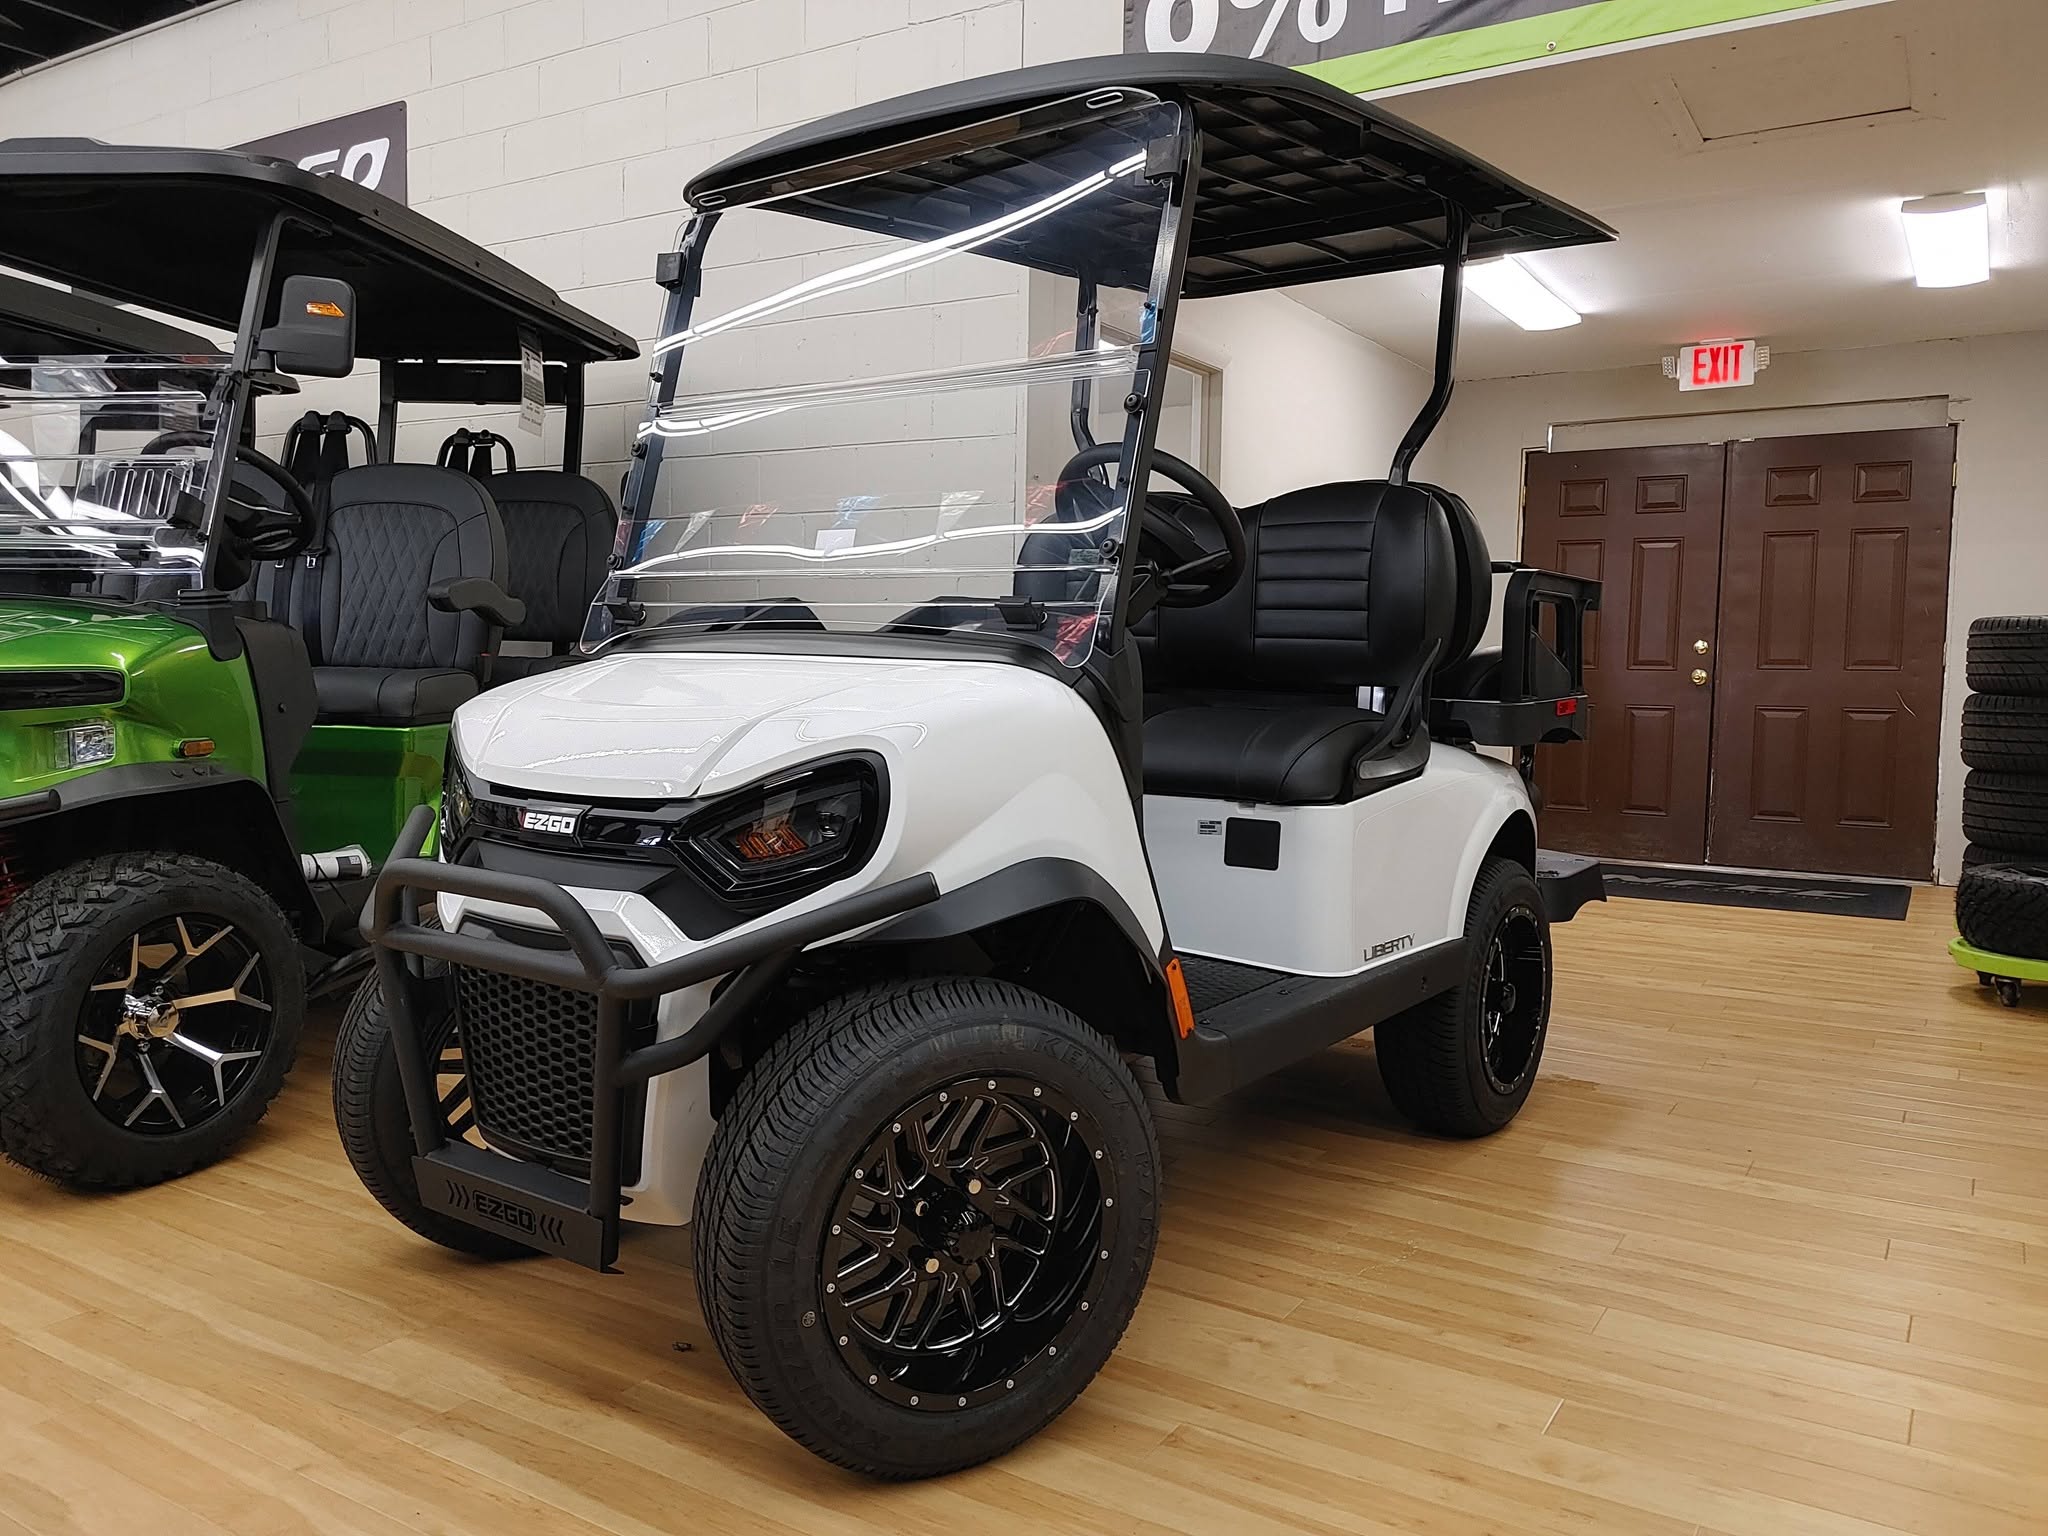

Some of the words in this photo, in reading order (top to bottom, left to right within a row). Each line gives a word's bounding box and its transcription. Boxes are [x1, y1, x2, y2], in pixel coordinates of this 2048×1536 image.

[1692, 344, 1744, 386] EXIT
[523, 812, 576, 834] EZGO
[1363, 933, 1415, 962] LIBERTY
[475, 1193, 534, 1232] EZGO
